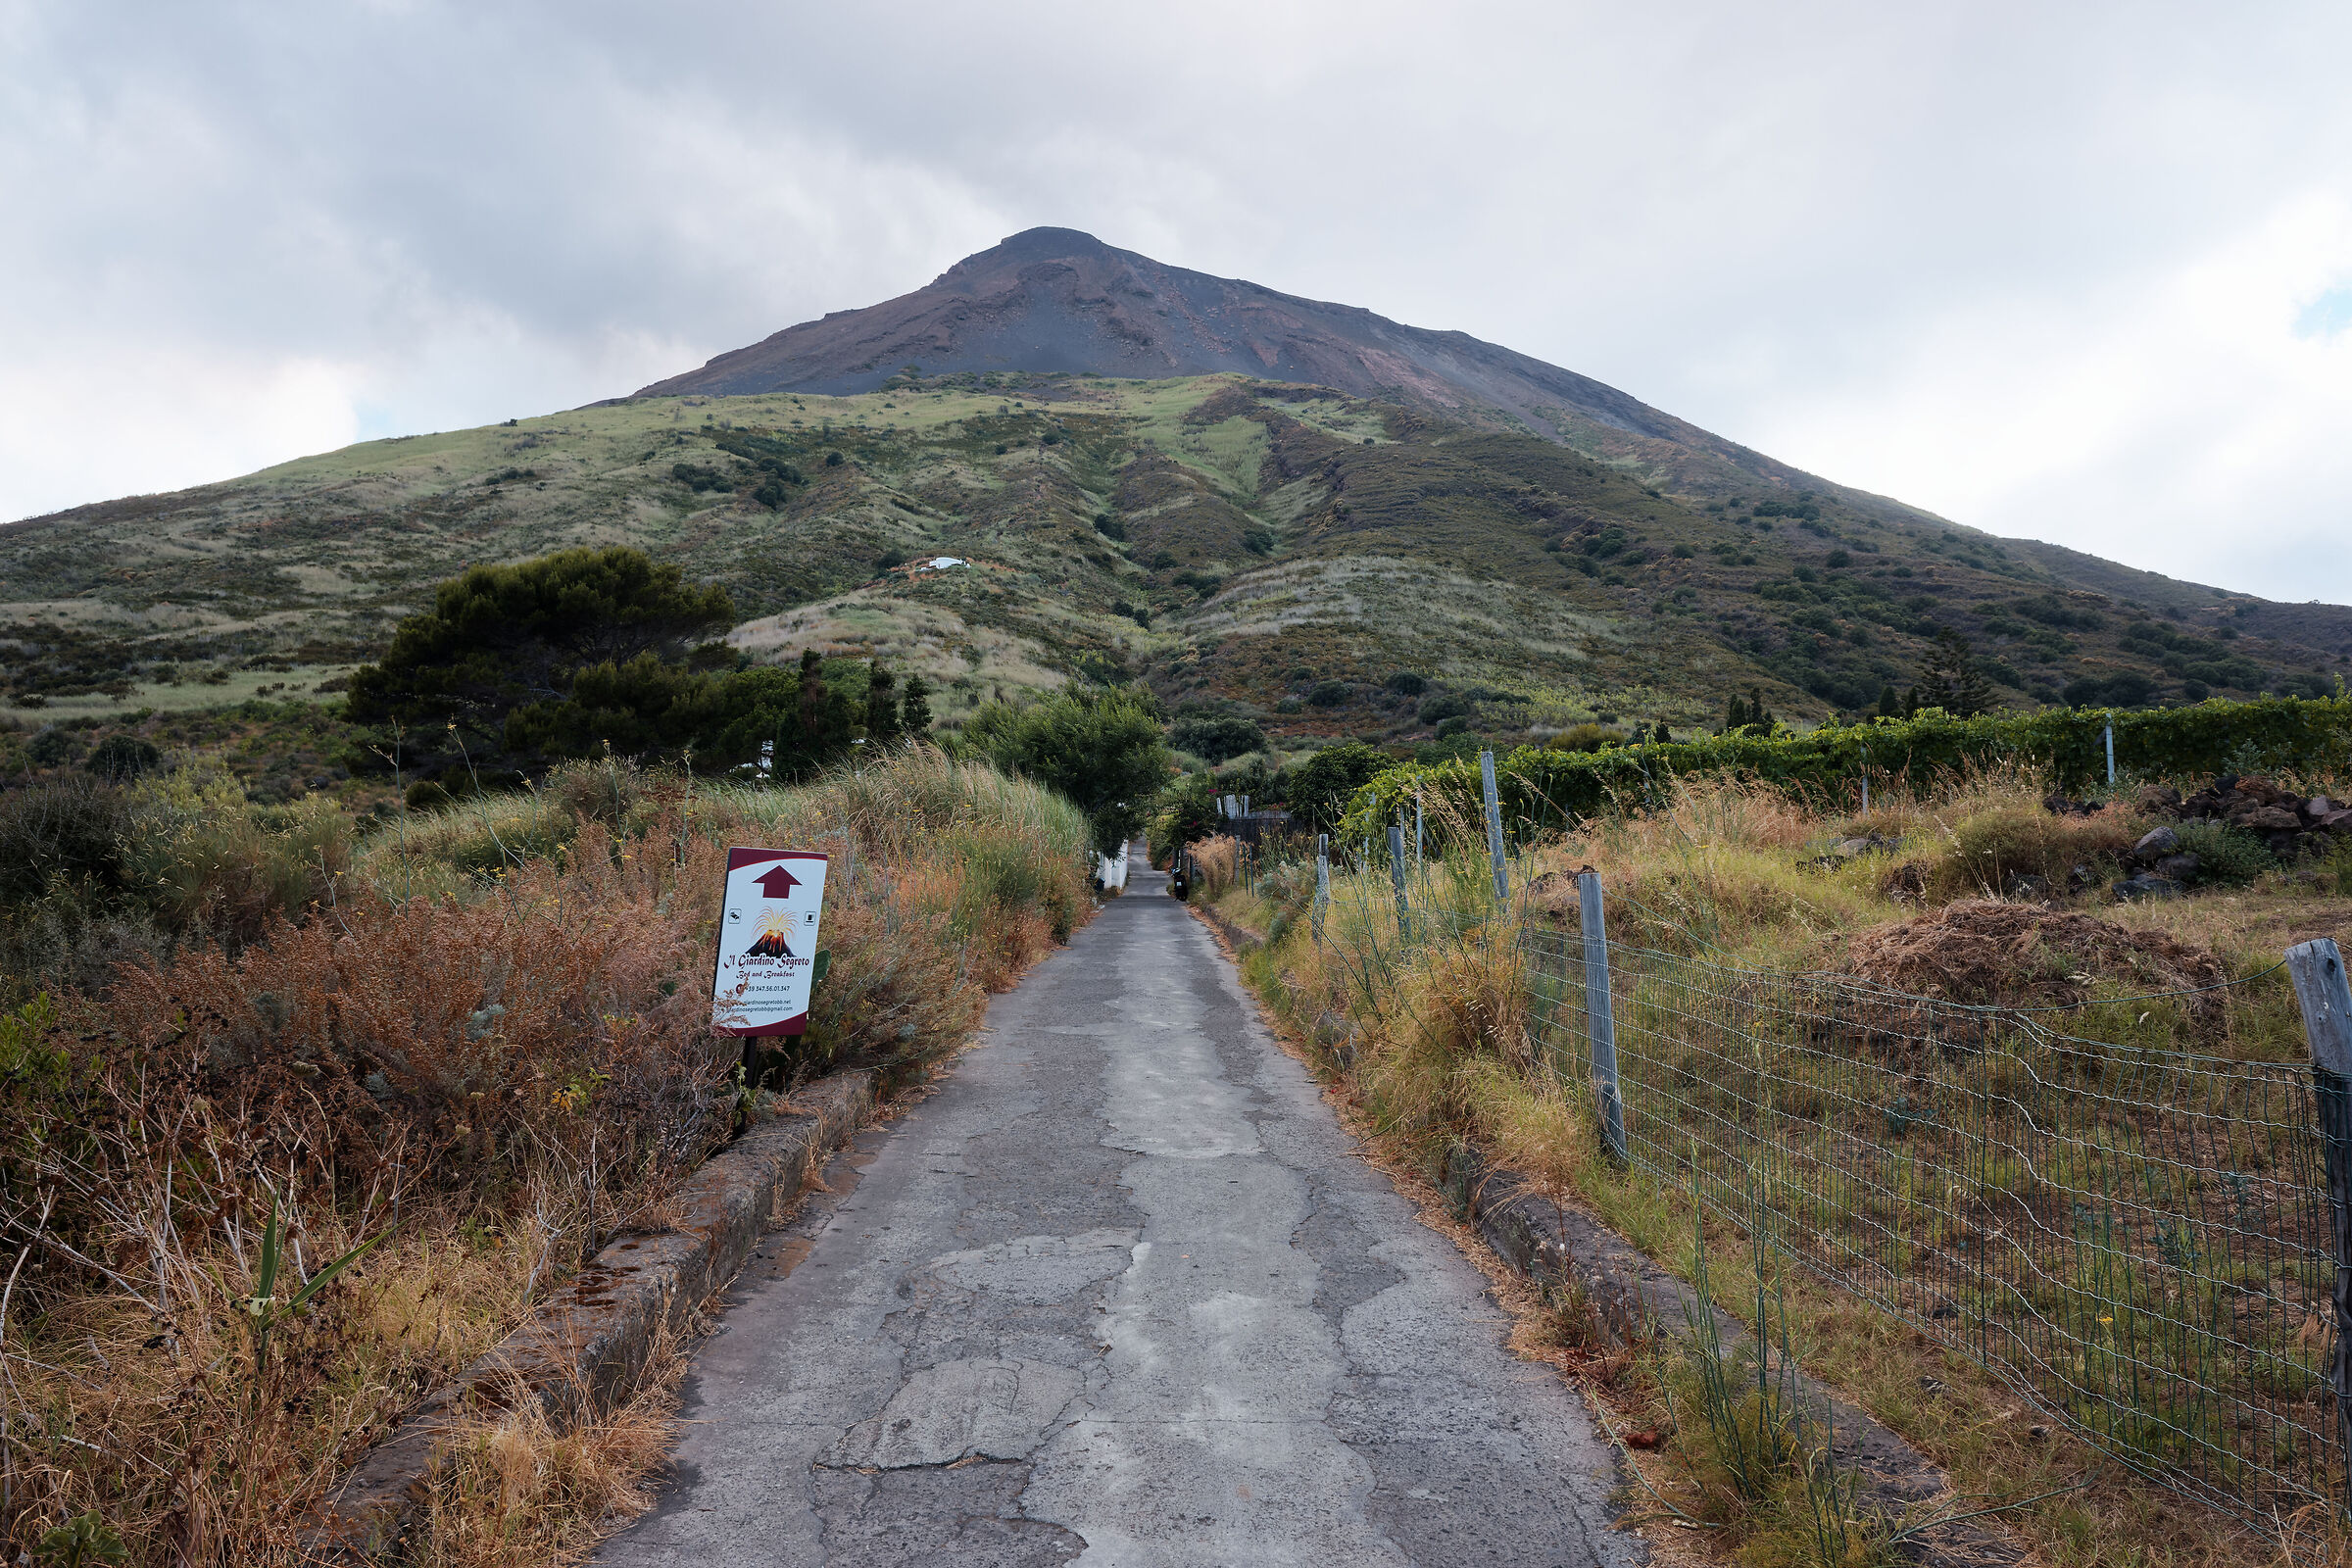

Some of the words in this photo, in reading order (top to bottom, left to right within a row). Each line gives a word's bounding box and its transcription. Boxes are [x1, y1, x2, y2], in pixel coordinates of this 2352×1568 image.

[738, 954, 775, 969] Giardino
[777, 955, 809, 970] Segreto
[736, 970, 751, 979] Bed
[763, 970, 795, 979] Breakfast
